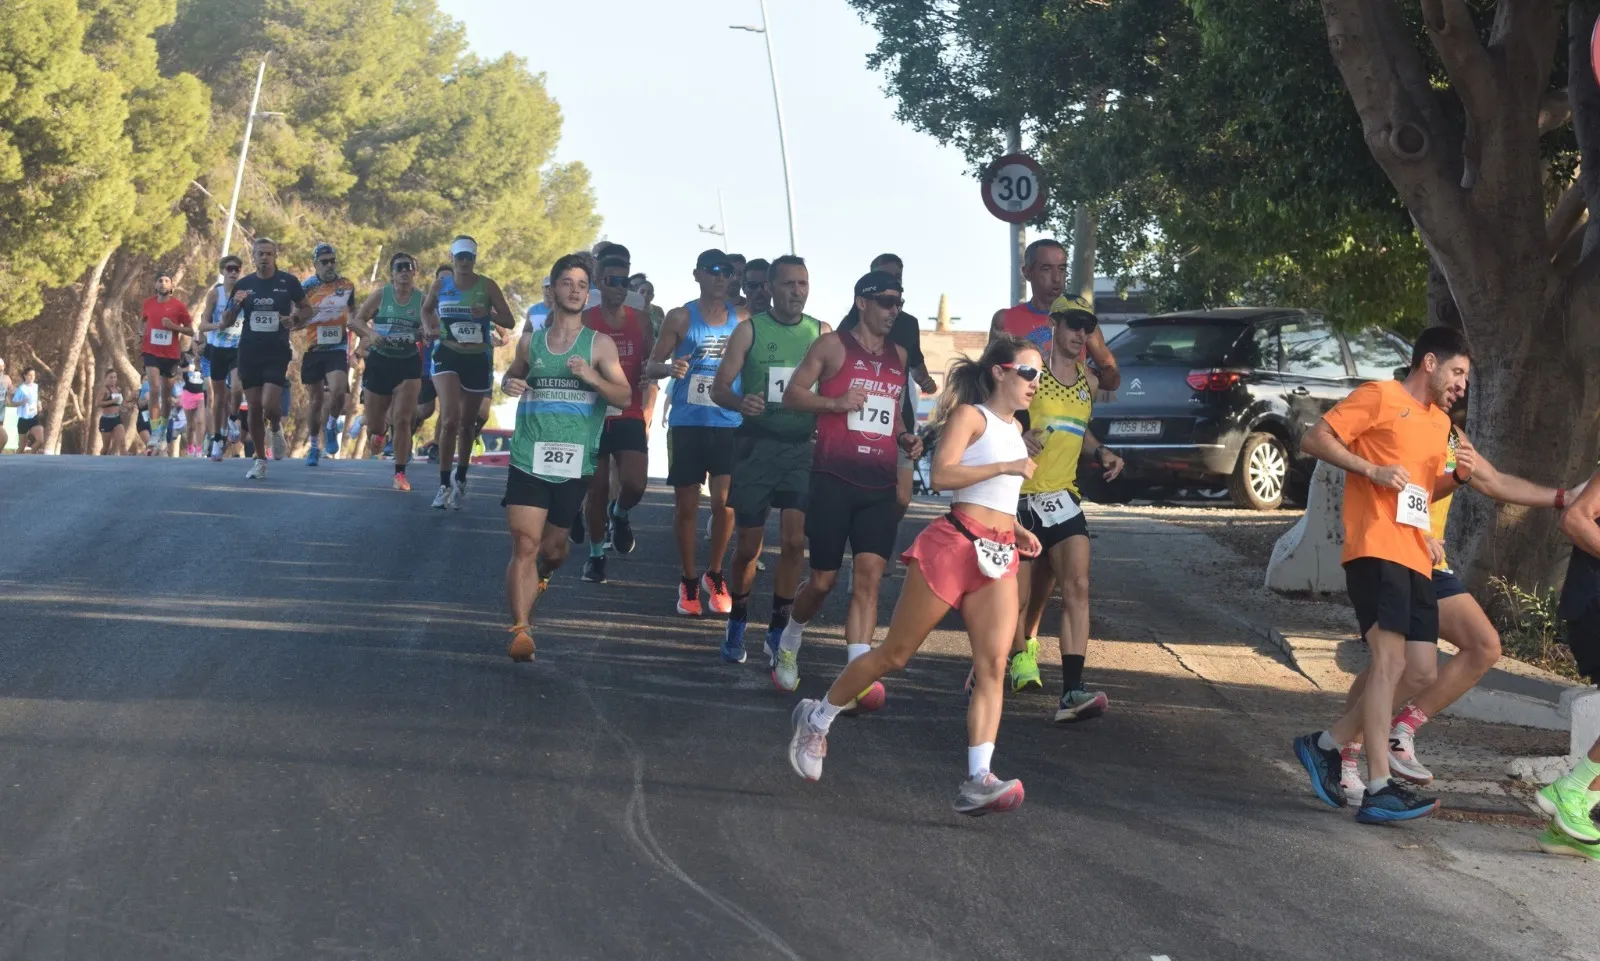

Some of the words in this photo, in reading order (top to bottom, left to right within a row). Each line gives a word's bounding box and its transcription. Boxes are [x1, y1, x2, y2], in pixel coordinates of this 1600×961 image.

[998, 175, 1031, 201] 30
[255, 316, 273, 325] 921
[457, 326, 476, 335] 467
[536, 377, 580, 389] ATLETISMO
[532, 390, 586, 401] ORREMOLINOS
[859, 407, 890, 425] 176
[543, 451, 574, 464] 287
